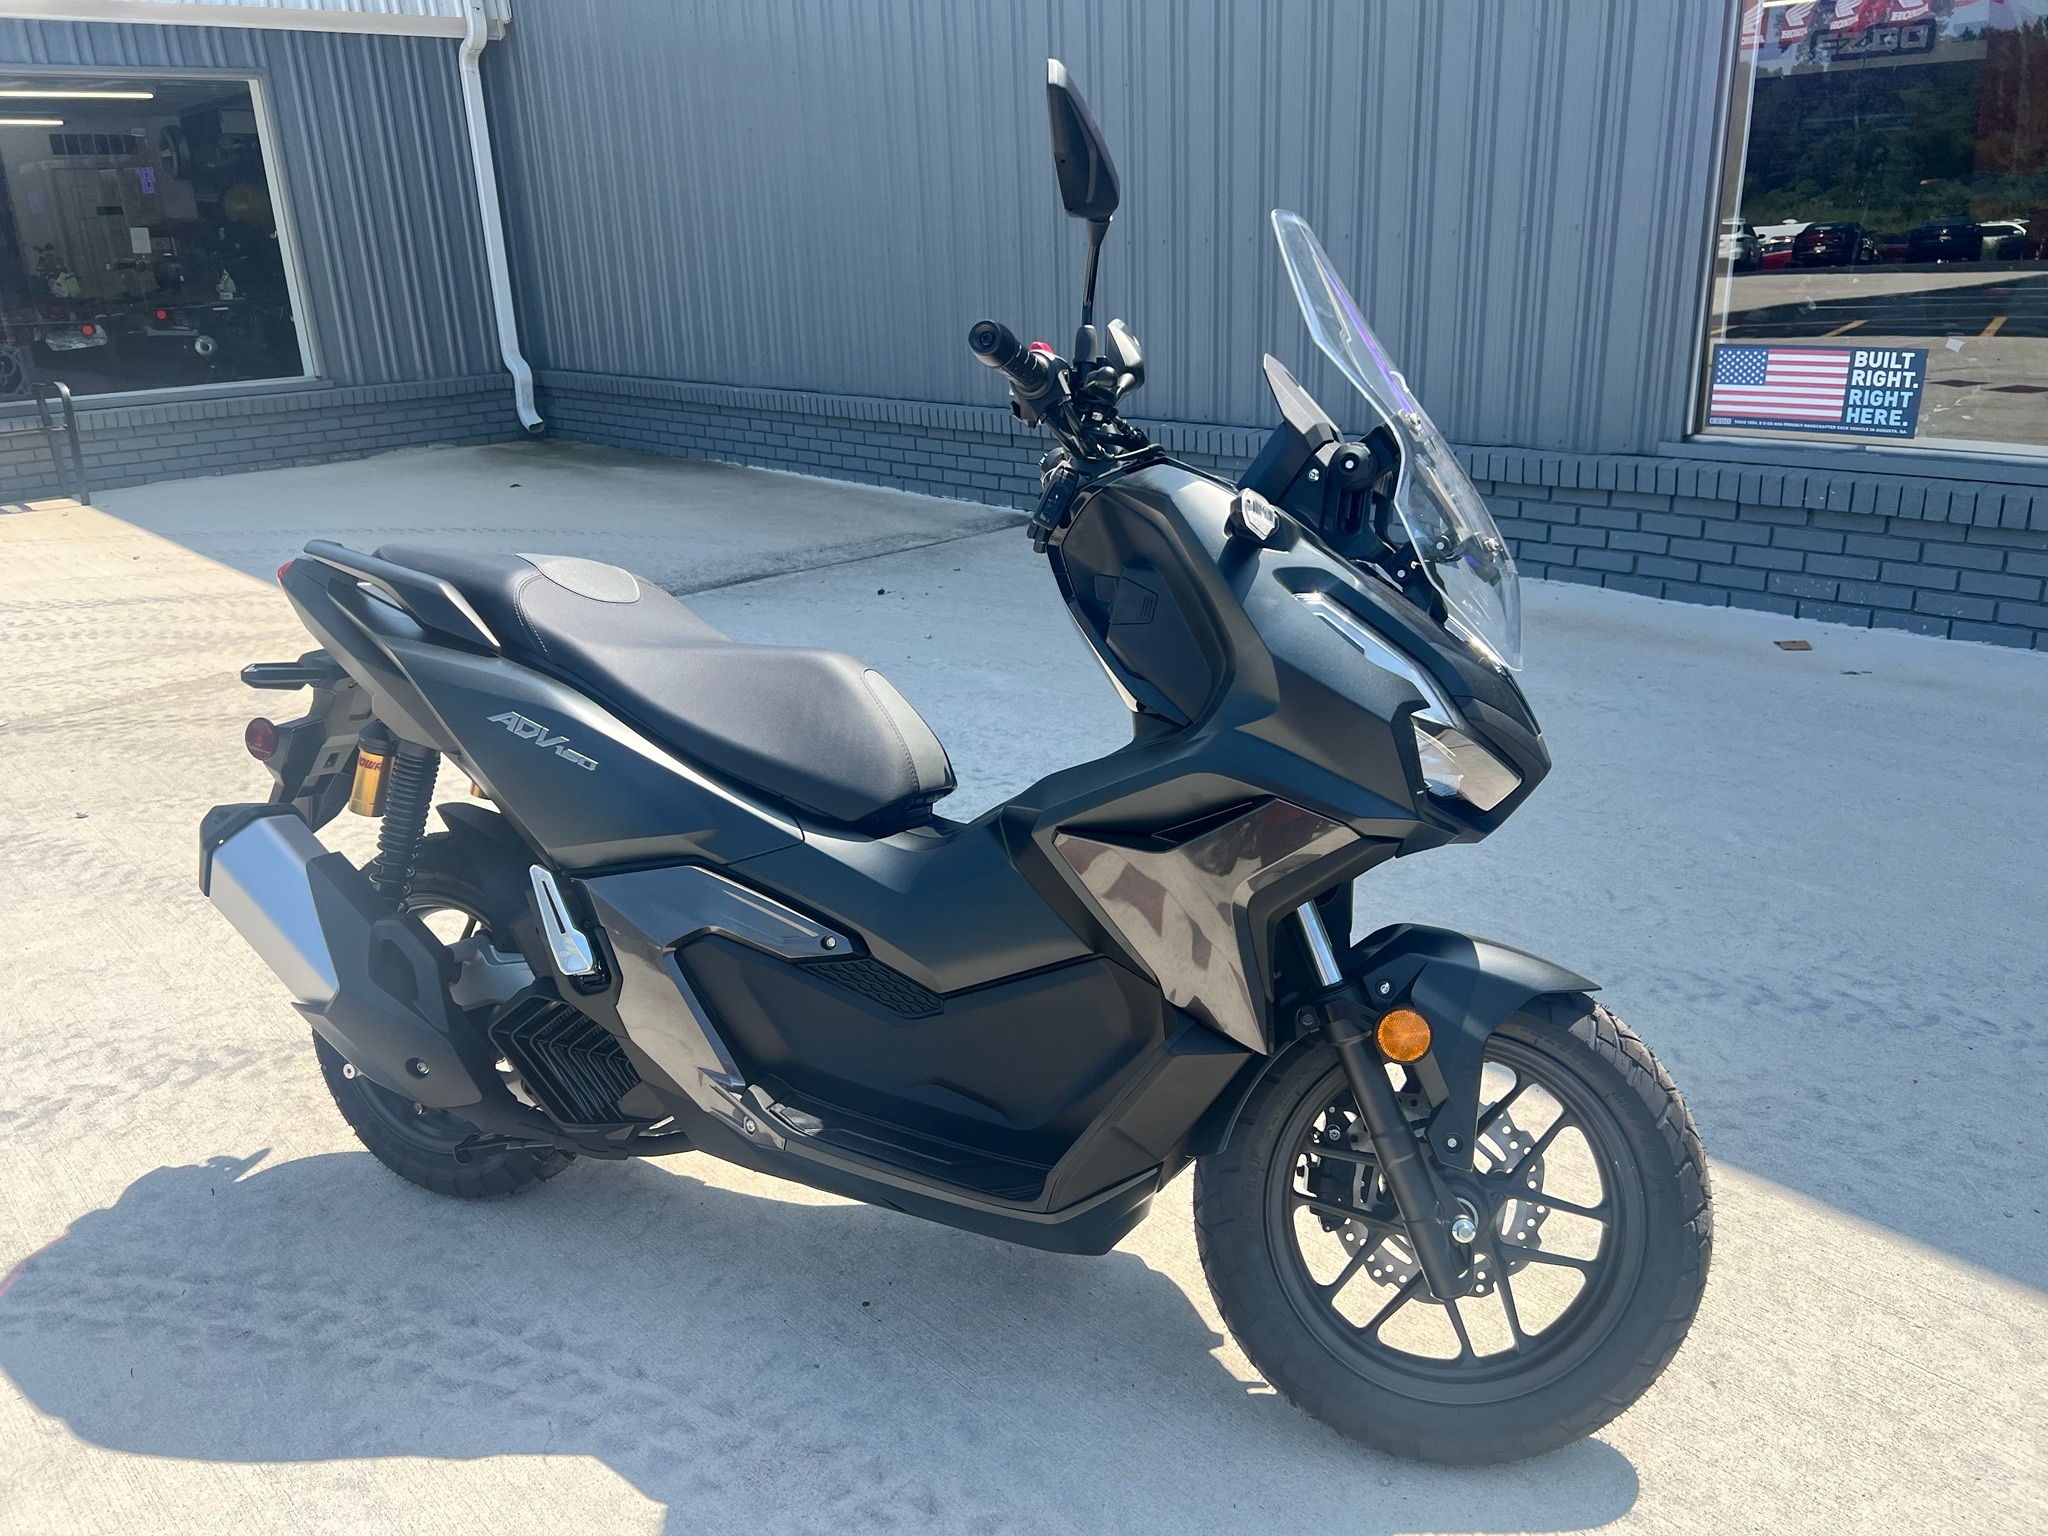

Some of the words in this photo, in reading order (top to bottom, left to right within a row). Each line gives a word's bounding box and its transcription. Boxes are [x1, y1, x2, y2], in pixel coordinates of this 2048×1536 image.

[1890, 4, 1929, 21] HONDA
[1854, 350, 1916, 369] BUILT
[1851, 369, 1919, 389] RIGHT.
[1848, 388, 1914, 408] RIGHT
[1845, 407, 1908, 427] HERE.
